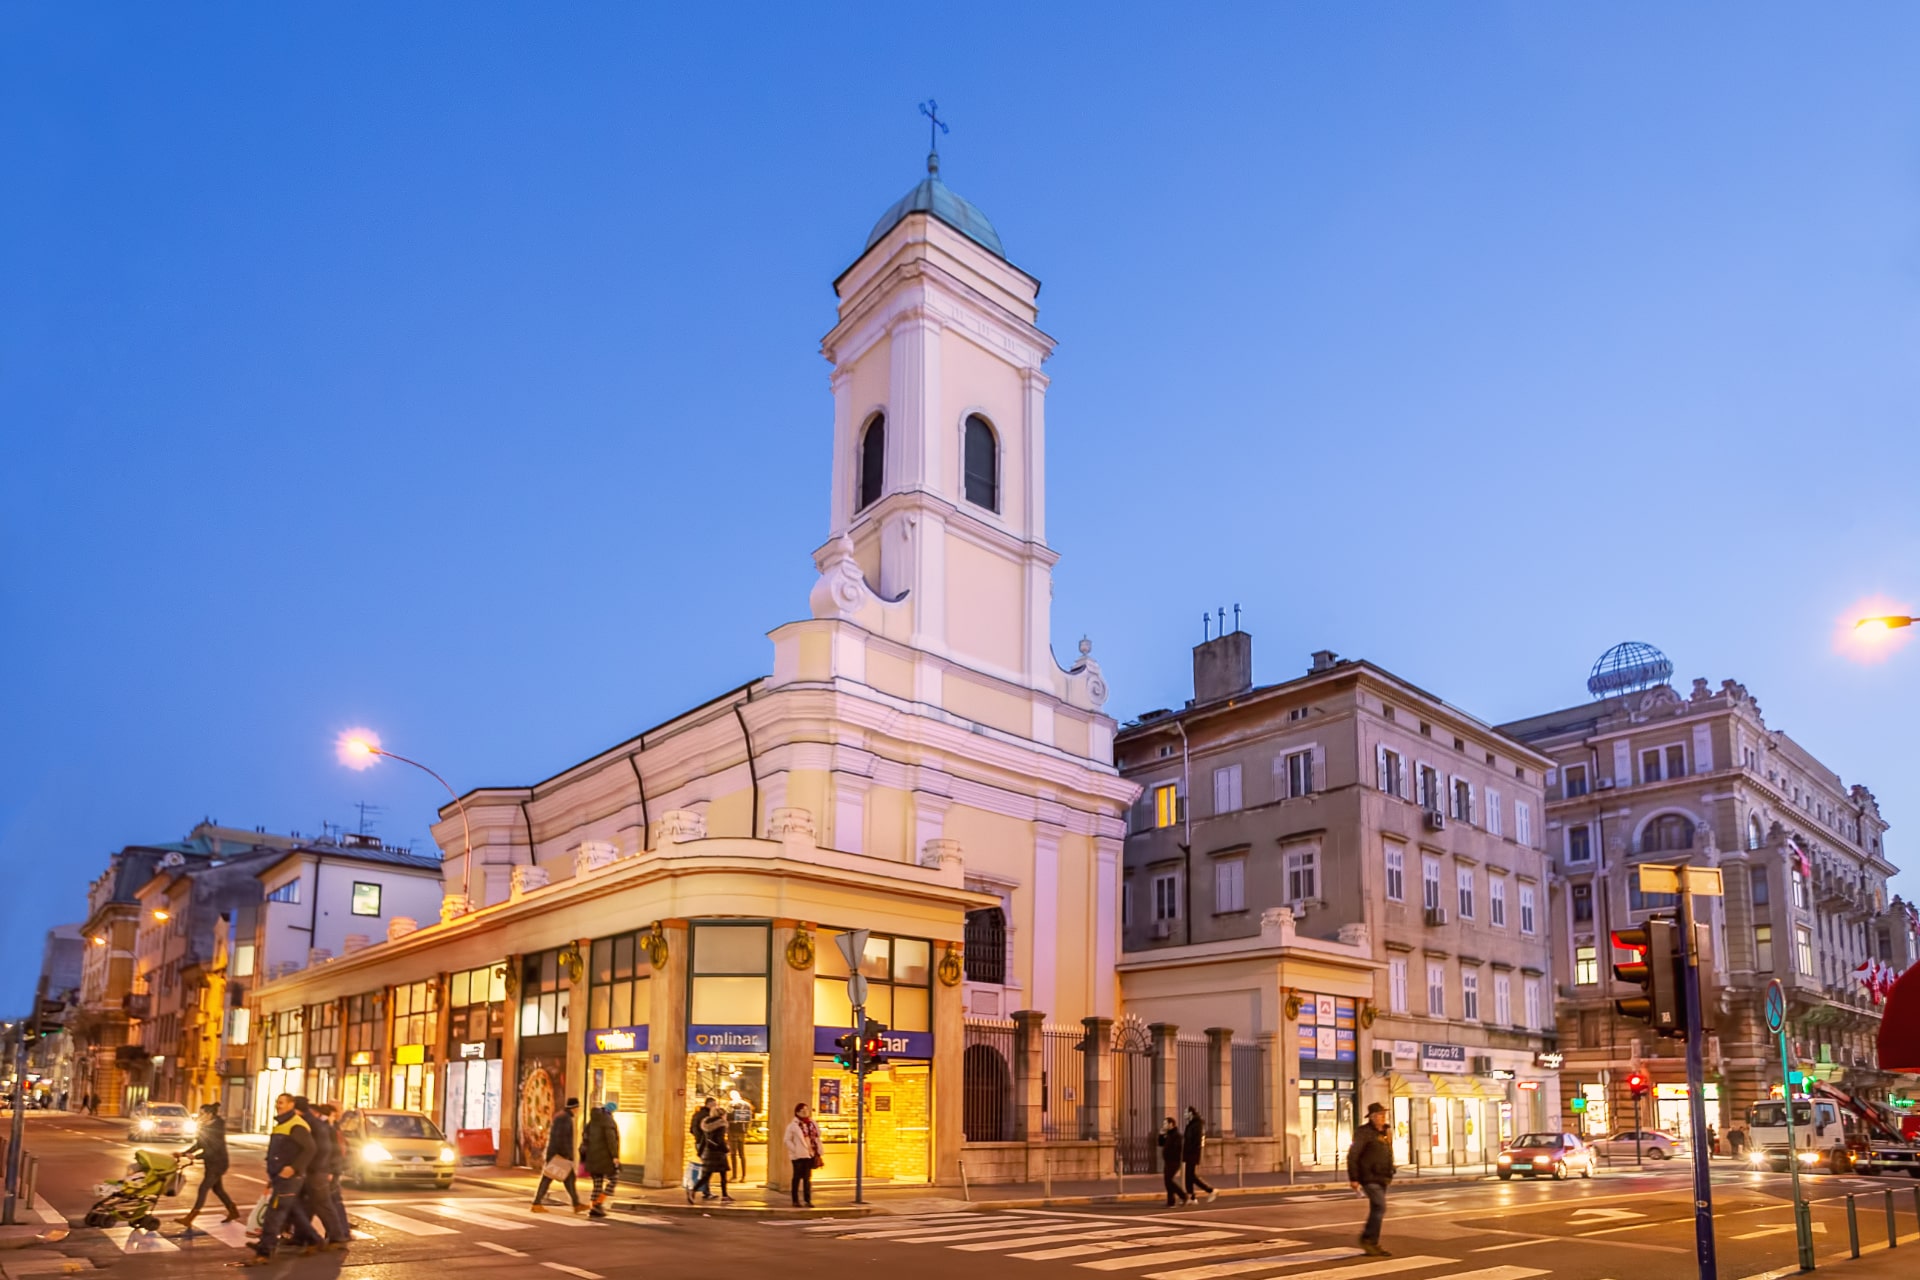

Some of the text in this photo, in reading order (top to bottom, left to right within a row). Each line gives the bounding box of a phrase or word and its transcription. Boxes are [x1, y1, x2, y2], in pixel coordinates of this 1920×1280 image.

[709, 1031, 758, 1046] mlinar
[1428, 1045, 1450, 1059] Europa
[1451, 1046, 1459, 1059] 92
